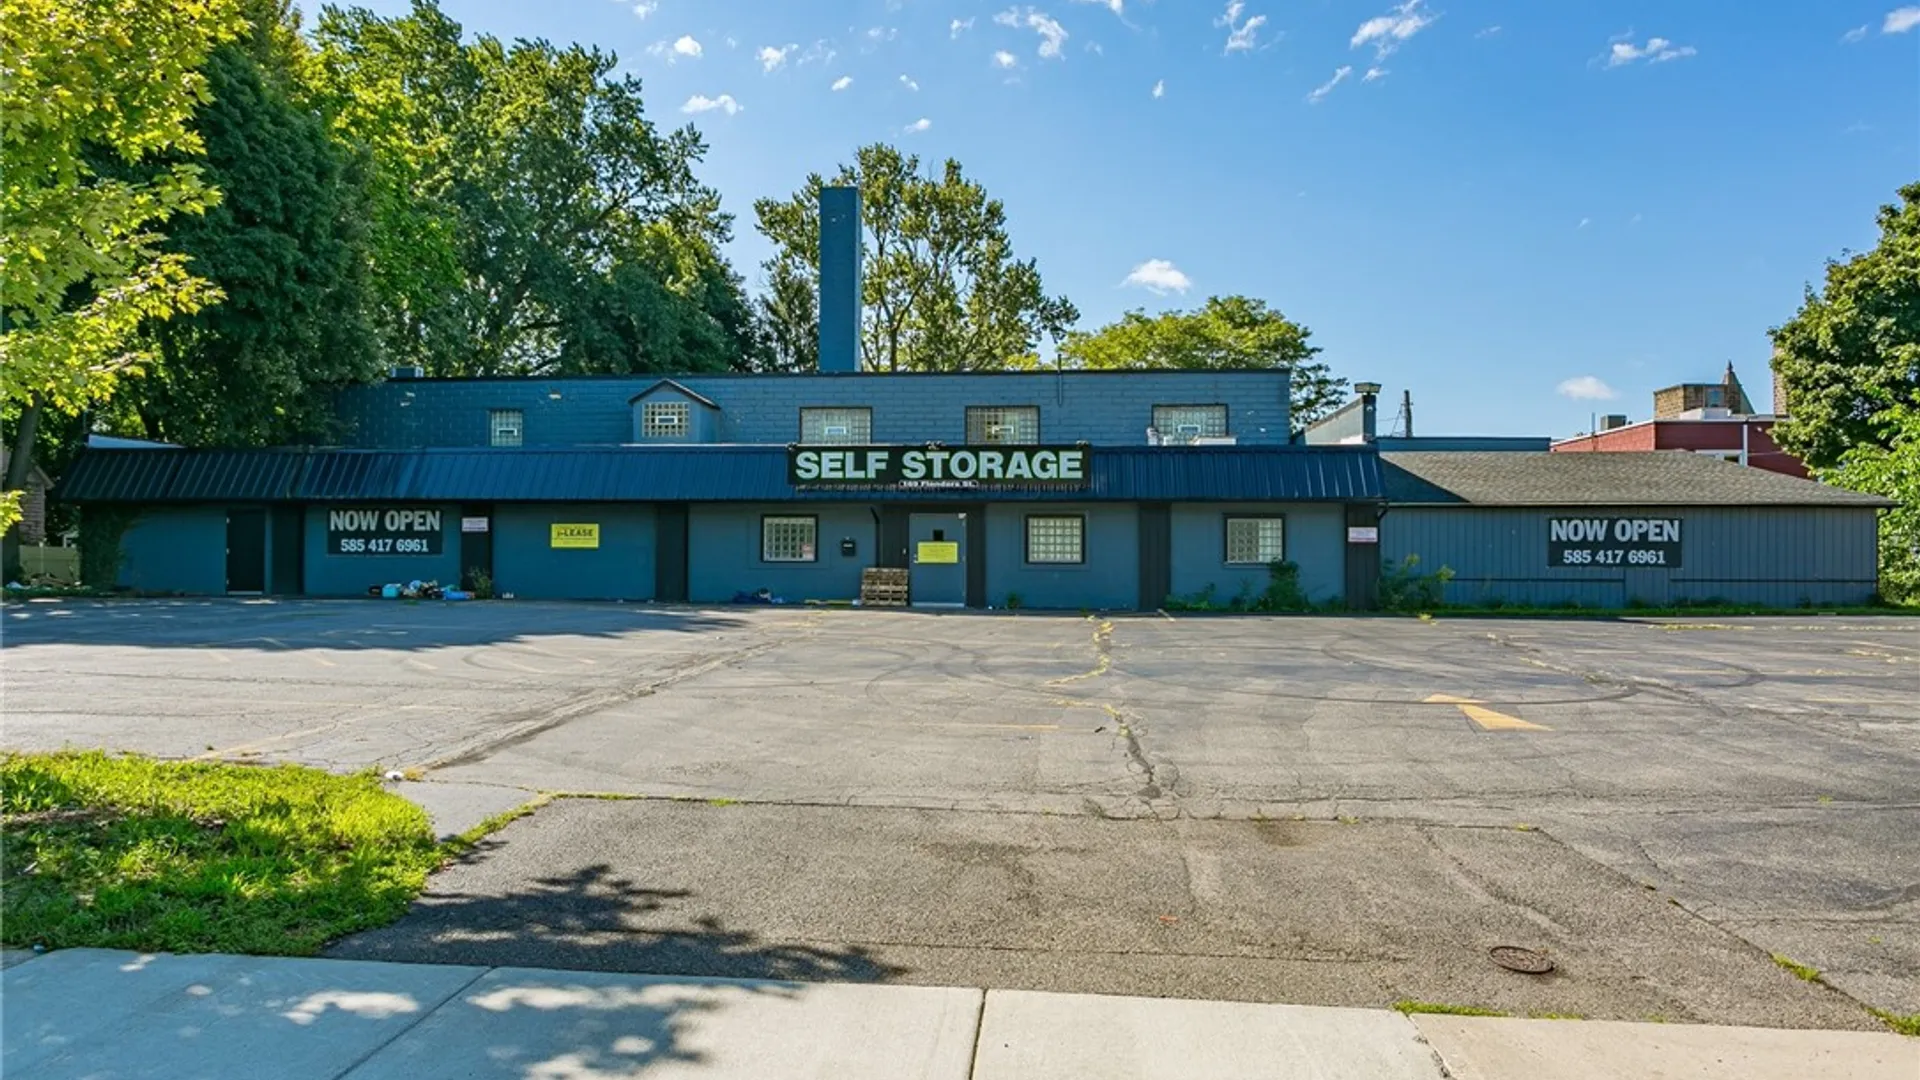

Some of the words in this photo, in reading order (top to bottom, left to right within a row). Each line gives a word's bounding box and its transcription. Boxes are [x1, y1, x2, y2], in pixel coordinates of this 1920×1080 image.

[795, 450, 889, 480] SELF
[901, 450, 1085, 480] STORAGE
[329, 510, 379, 532] NOW
[384, 510, 441, 532] OPEN
[564, 528, 594, 537] LEASE
[1550, 519, 1609, 543] NOW
[1614, 519, 1680, 543] OPEN
[340, 538, 366, 553] 585
[367, 538, 392, 553] 417
[396, 538, 429, 553] 6961
[1563, 549, 1592, 564] 585
[1595, 549, 1624, 564] 417
[1628, 549, 1666, 564] 6961
